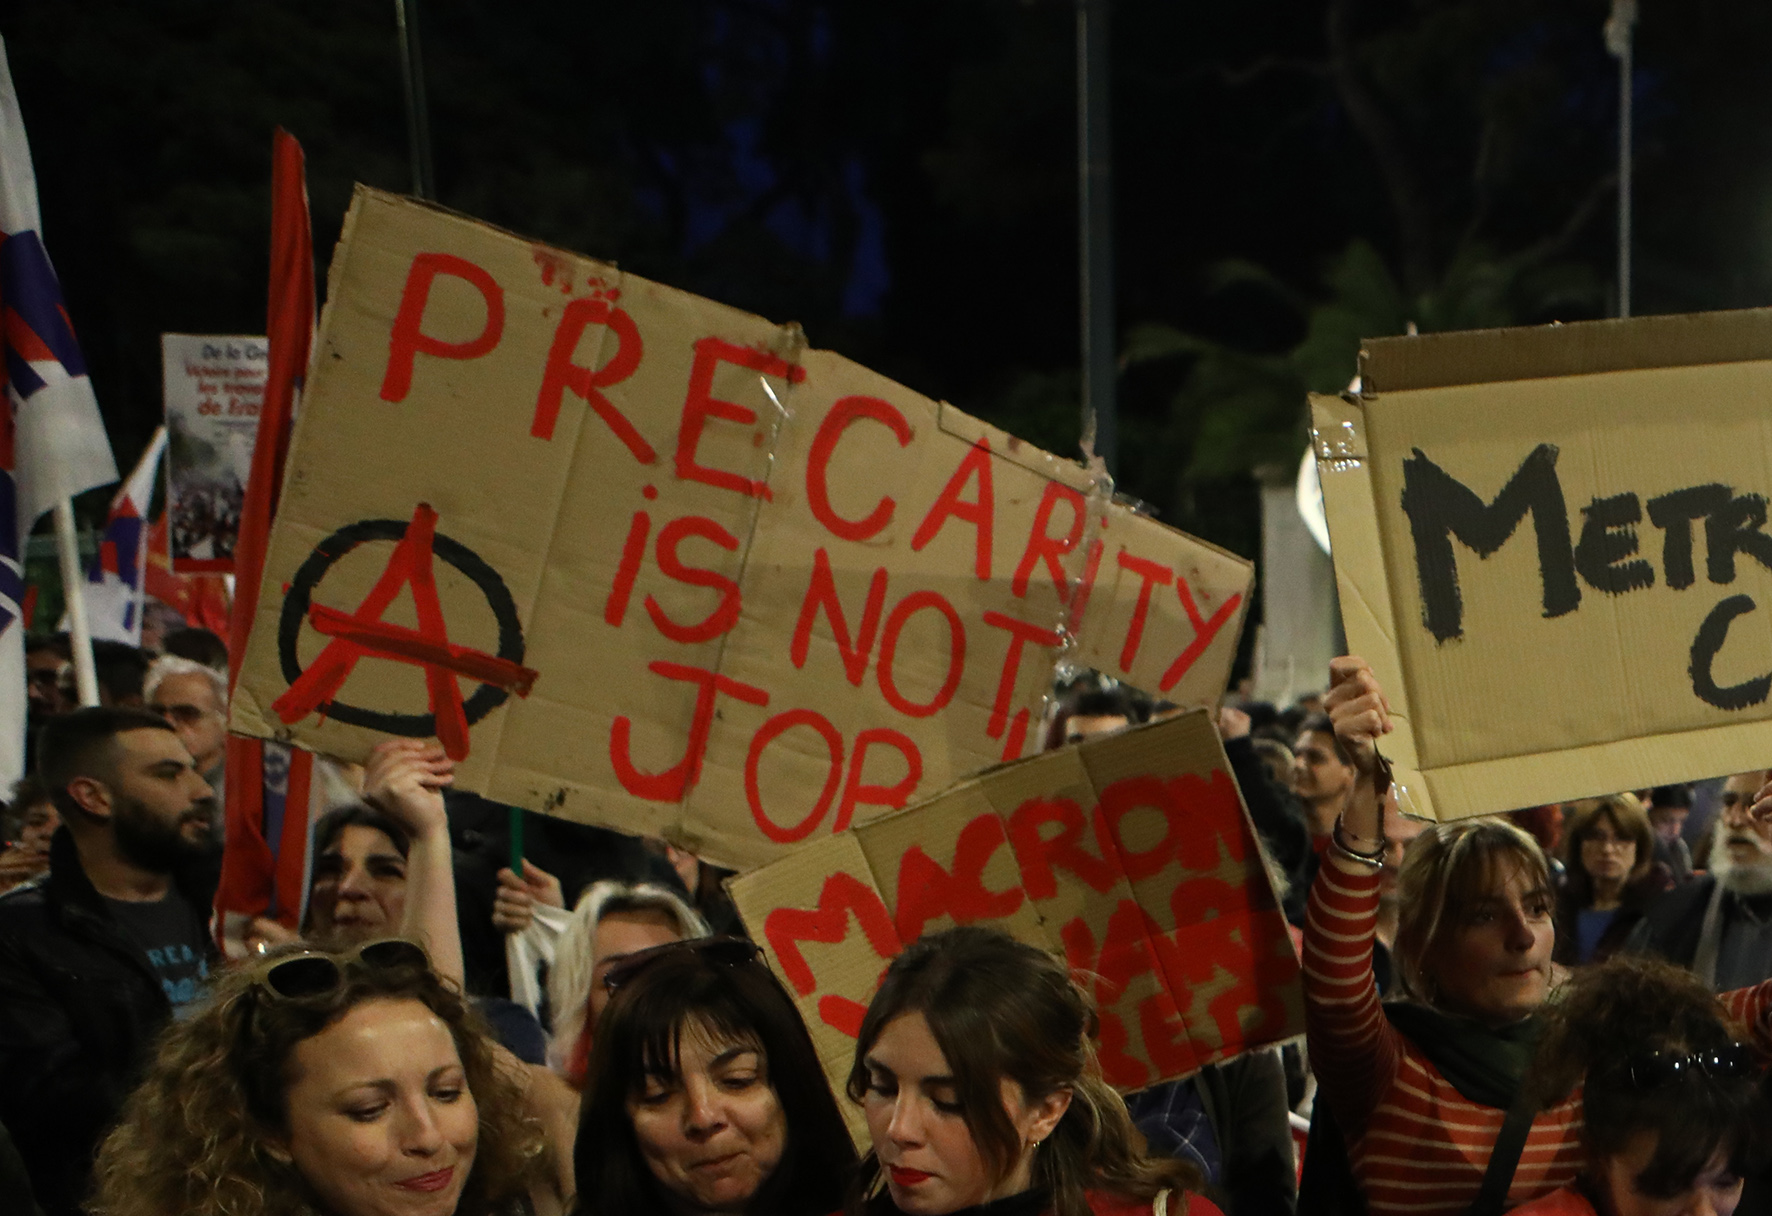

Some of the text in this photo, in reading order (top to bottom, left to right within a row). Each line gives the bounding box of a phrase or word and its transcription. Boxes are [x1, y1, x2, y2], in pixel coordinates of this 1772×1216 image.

[379, 252, 1243, 693] PRECARITY
[790, 547, 1064, 740] NOT
[763, 767, 1250, 998] MACRON
